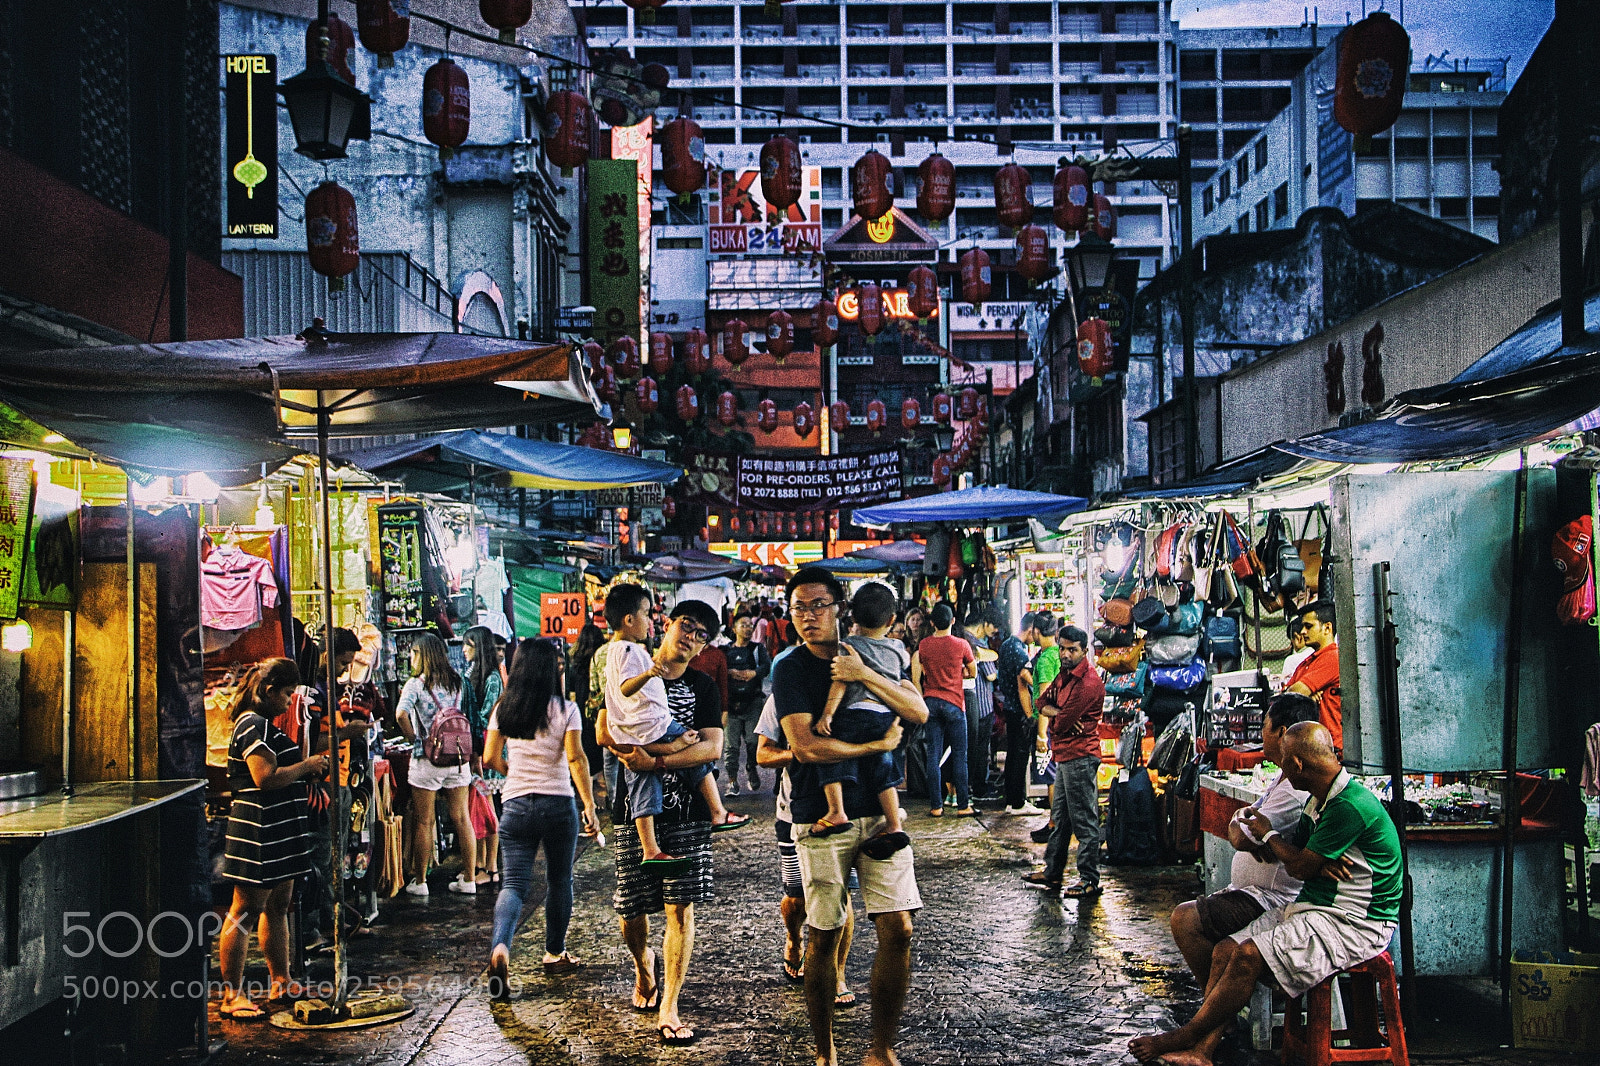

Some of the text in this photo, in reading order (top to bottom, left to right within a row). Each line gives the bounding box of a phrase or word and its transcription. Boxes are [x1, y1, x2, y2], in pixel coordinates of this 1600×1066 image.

[227, 56, 271, 74] HOTEL
[229, 224, 274, 235] LANTERN
[711, 227, 820, 250] BUKA 24 JAM
[850, 250, 910, 260] KOSMETIK
[741, 465, 900, 485] FOR PRE-ORDERS, PLEASE CALL
[598, 492, 662, 505] FOOD CENTRE
[741, 486, 752, 496] 03
[754, 487, 776, 498] 2072
[777, 488, 799, 499] 8888
[801, 487, 822, 499] (TEL)
[826, 486, 843, 497] 012
[741, 543, 790, 565] KK
[563, 599, 580, 616] 10
[545, 617, 563, 634] 10
